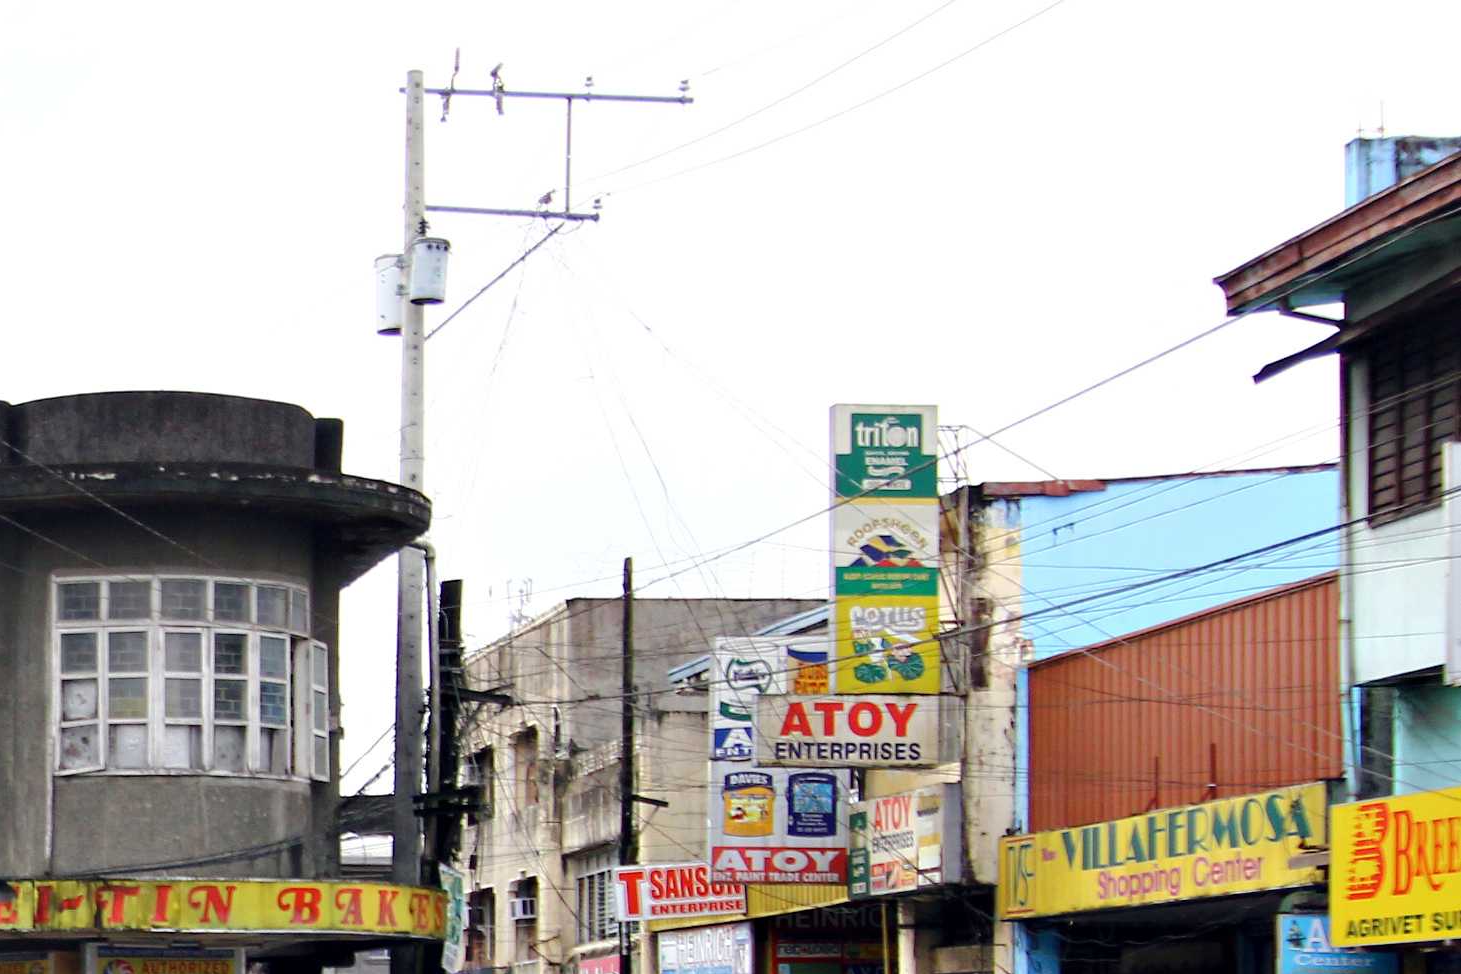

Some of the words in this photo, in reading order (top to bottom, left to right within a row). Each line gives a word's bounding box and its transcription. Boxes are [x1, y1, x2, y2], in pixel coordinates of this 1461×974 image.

[780, 701, 919, 738] ATOY
[774, 742, 922, 761] ENTERPRISES
[729, 773, 769, 786] DAVIES
[873, 794, 913, 833] ATOY
[1060, 794, 1313, 871] VILLAHERMOSA
[714, 849, 840, 873] ATOY
[618, 871, 644, 917] T
[649, 865, 745, 900] SANSON
[770, 872, 800, 882] TRADE
[803, 872, 840, 882] CENTER
[1096, 864, 1182, 901] Shopping
[1193, 855, 1262, 888] Center
[650, 900, 744, 916] ENTERPRISE
[1346, 914, 1425, 939] AGRIVET
[1431, 910, 1461, 933] SU
